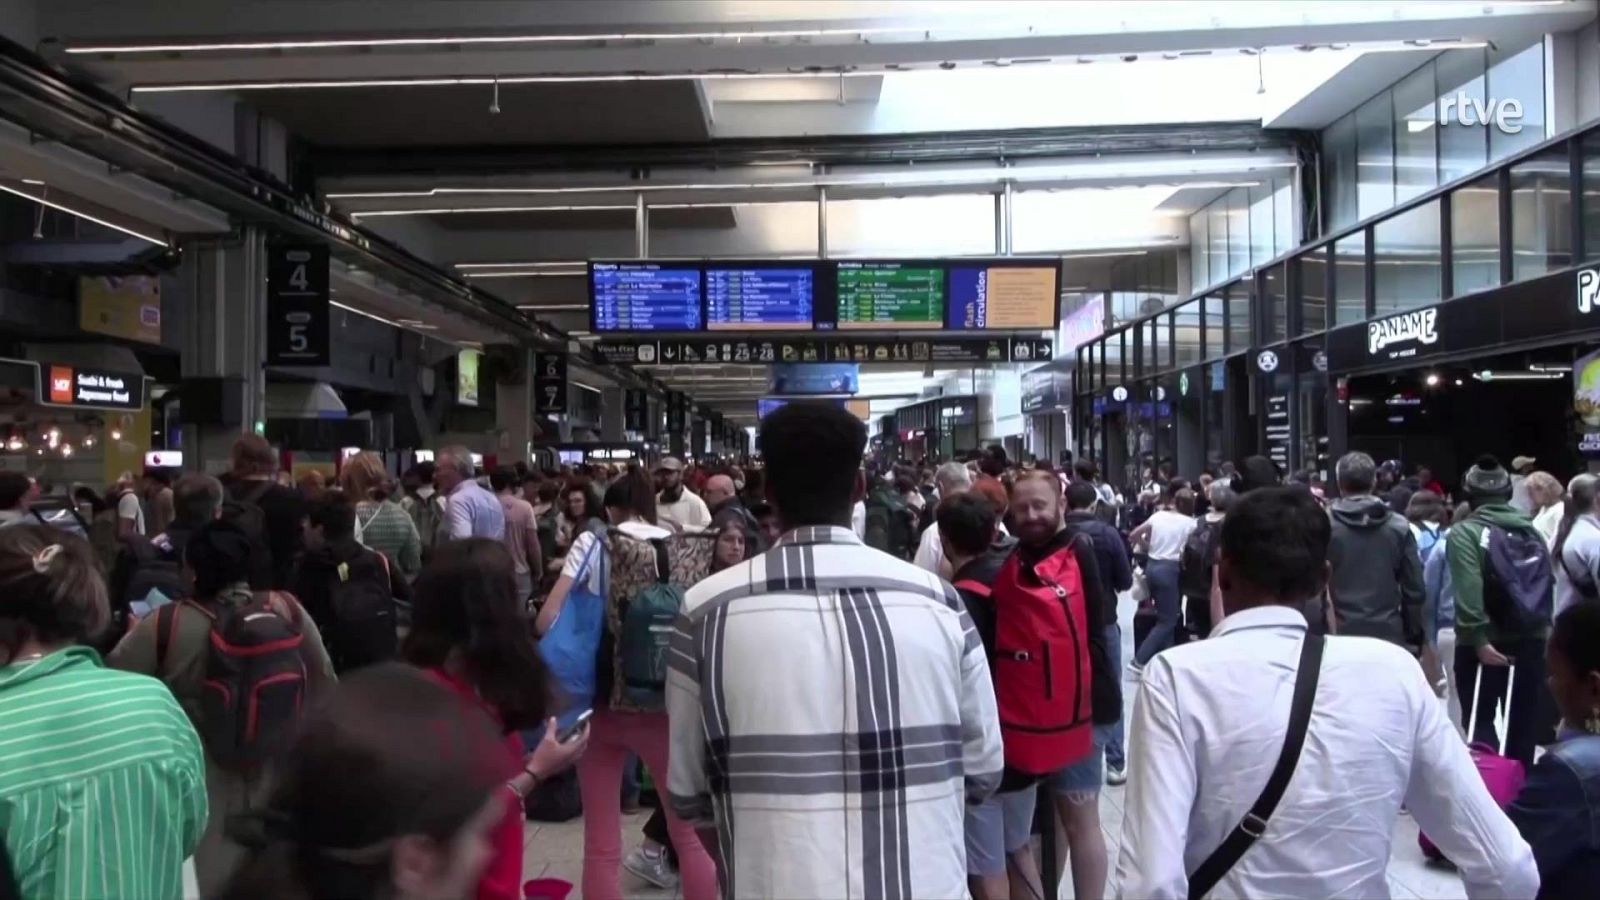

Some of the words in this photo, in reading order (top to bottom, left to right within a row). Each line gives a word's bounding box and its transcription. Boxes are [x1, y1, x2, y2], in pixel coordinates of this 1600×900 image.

[288, 264, 309, 291] 4
[975, 270, 986, 328] circulation
[288, 325, 308, 352] 5
[1368, 307, 1438, 354] PANAME
[734, 346, 751, 360] 25
[759, 346, 774, 360] 28
[546, 362, 557, 375] 6
[546, 392, 558, 408] 7
